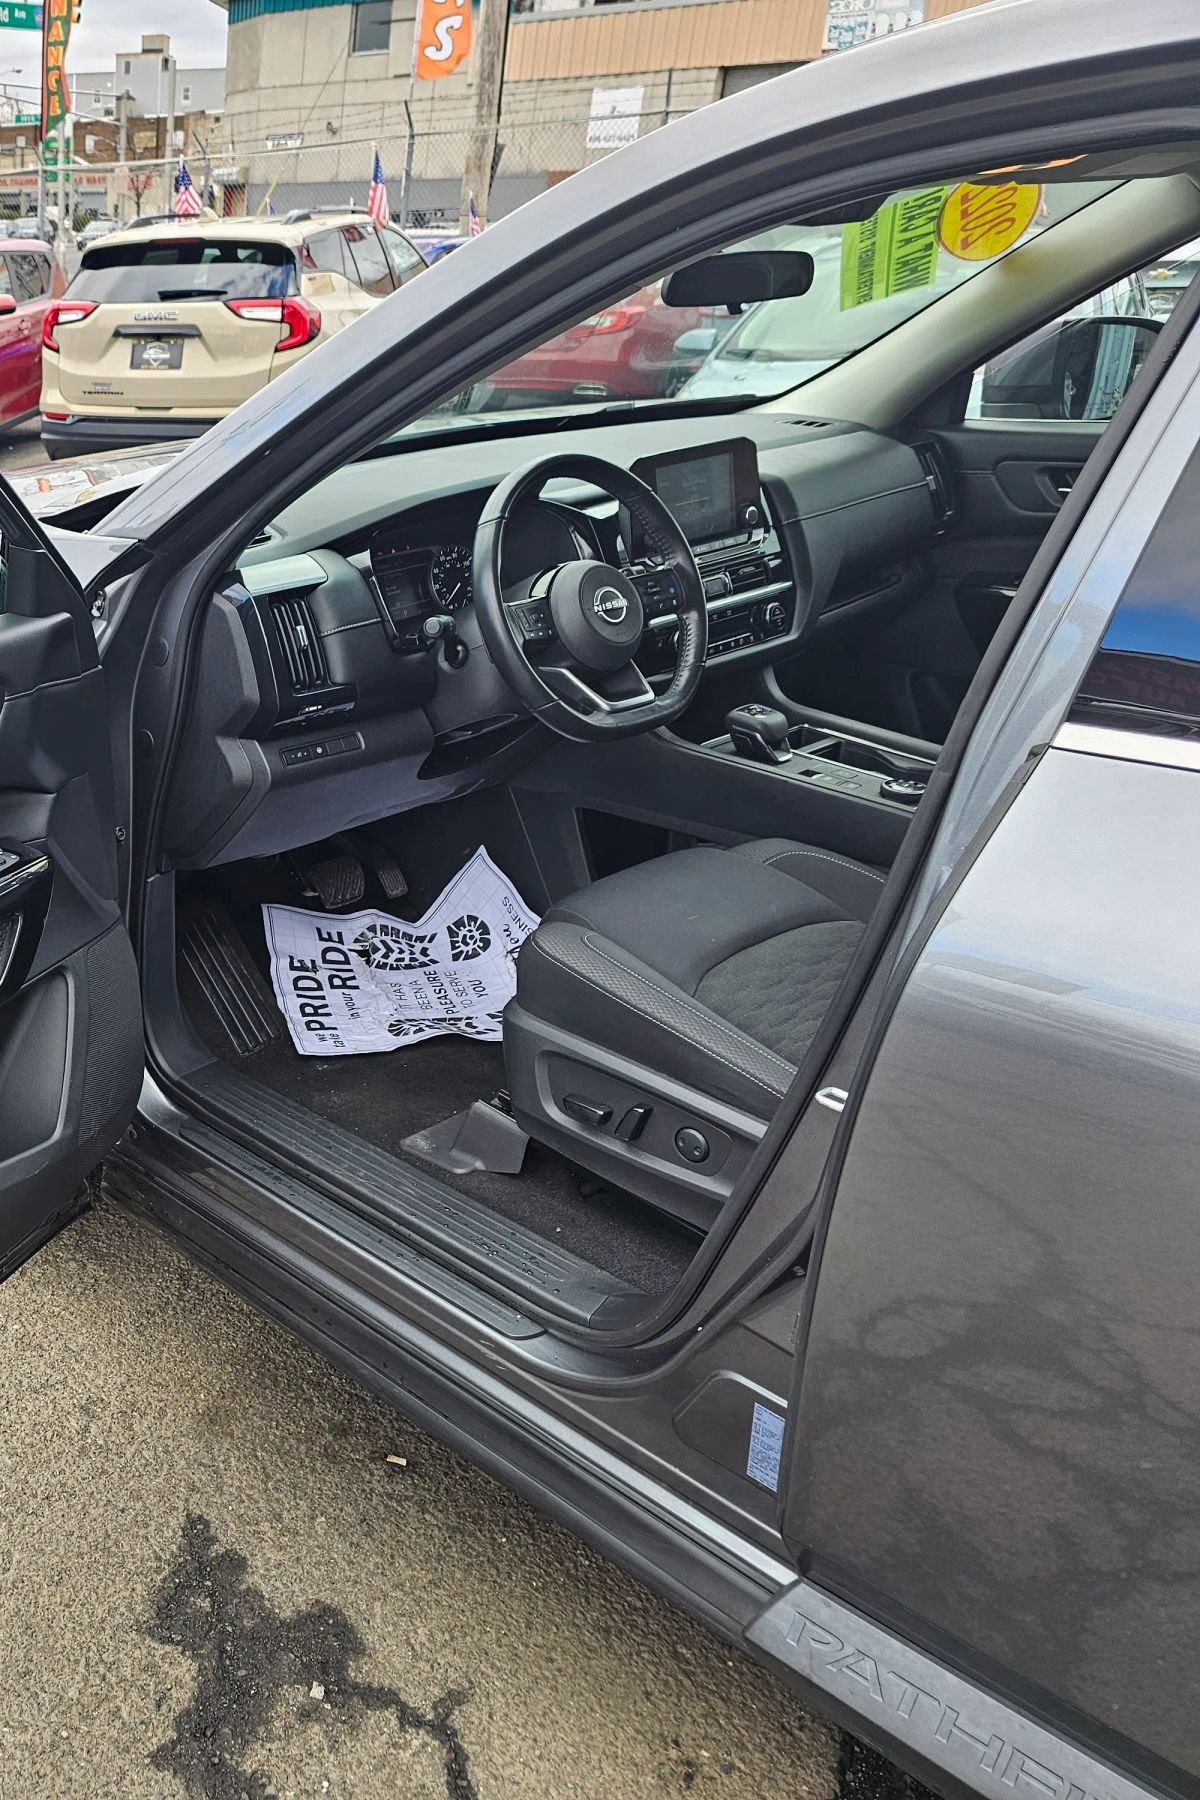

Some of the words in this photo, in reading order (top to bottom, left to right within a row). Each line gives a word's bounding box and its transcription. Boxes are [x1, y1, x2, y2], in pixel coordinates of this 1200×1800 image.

[14, 8, 26, 19] Ave
[423, 0, 464, 61] S
[134, 309, 179, 321] GMC
[593, 598, 628, 614] NISSAN
[502, 896, 534, 936] SINESS
[315, 926, 361, 990] RIDE
[288, 954, 338, 1031] PRIDE
[390, 982, 408, 1001] HAS
[424, 970, 460, 1015] PLEASURE
[444, 970, 468, 998] SERVE
[468, 979, 489, 998] YOU
[341, 991, 361, 1012] your
[412, 987, 433, 1010] BEEN
[348, 1011, 361, 1021] in
